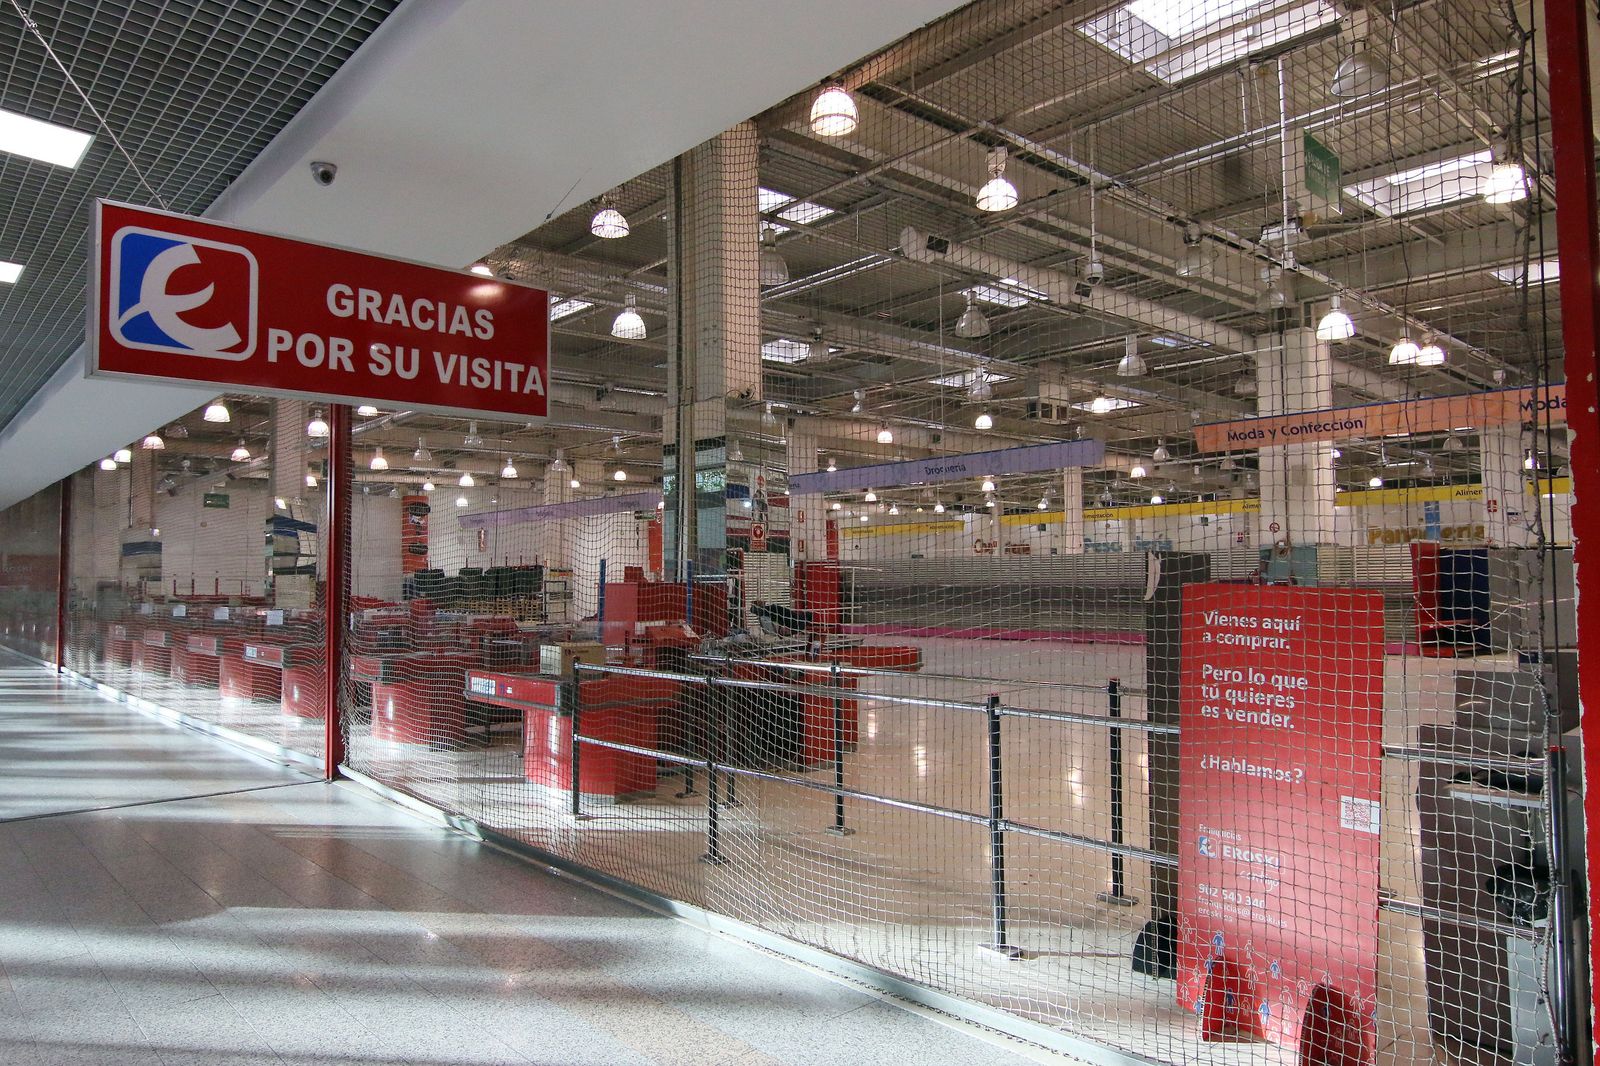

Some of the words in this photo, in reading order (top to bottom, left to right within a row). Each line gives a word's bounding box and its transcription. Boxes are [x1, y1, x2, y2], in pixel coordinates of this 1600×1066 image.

[326, 283, 495, 341] GRACIAS
[267, 327, 355, 373] POR
[367, 342, 420, 381] SU
[432, 351, 545, 396] VISITA
[1227, 428, 1265, 442] Moda
[1268, 428, 1276, 439] y
[1203, 610, 1257, 629] Vienes
[1262, 616, 1301, 633] aquí
[1203, 631, 1212, 643] a
[1217, 632, 1291, 650] comprar.
[1203, 663, 1243, 682] Pero
[1248, 667, 1266, 686] lo
[1271, 673, 1308, 692] que
[1201, 683, 1219, 700] tú
[1225, 687, 1295, 709] quieres
[1201, 704, 1219, 719] es
[1225, 707, 1295, 729] vender.
[1200, 754, 1303, 784] ¿Hablamos?
[1223, 844, 1279, 868] EROSKI
[1222, 889, 1243, 904] 540
